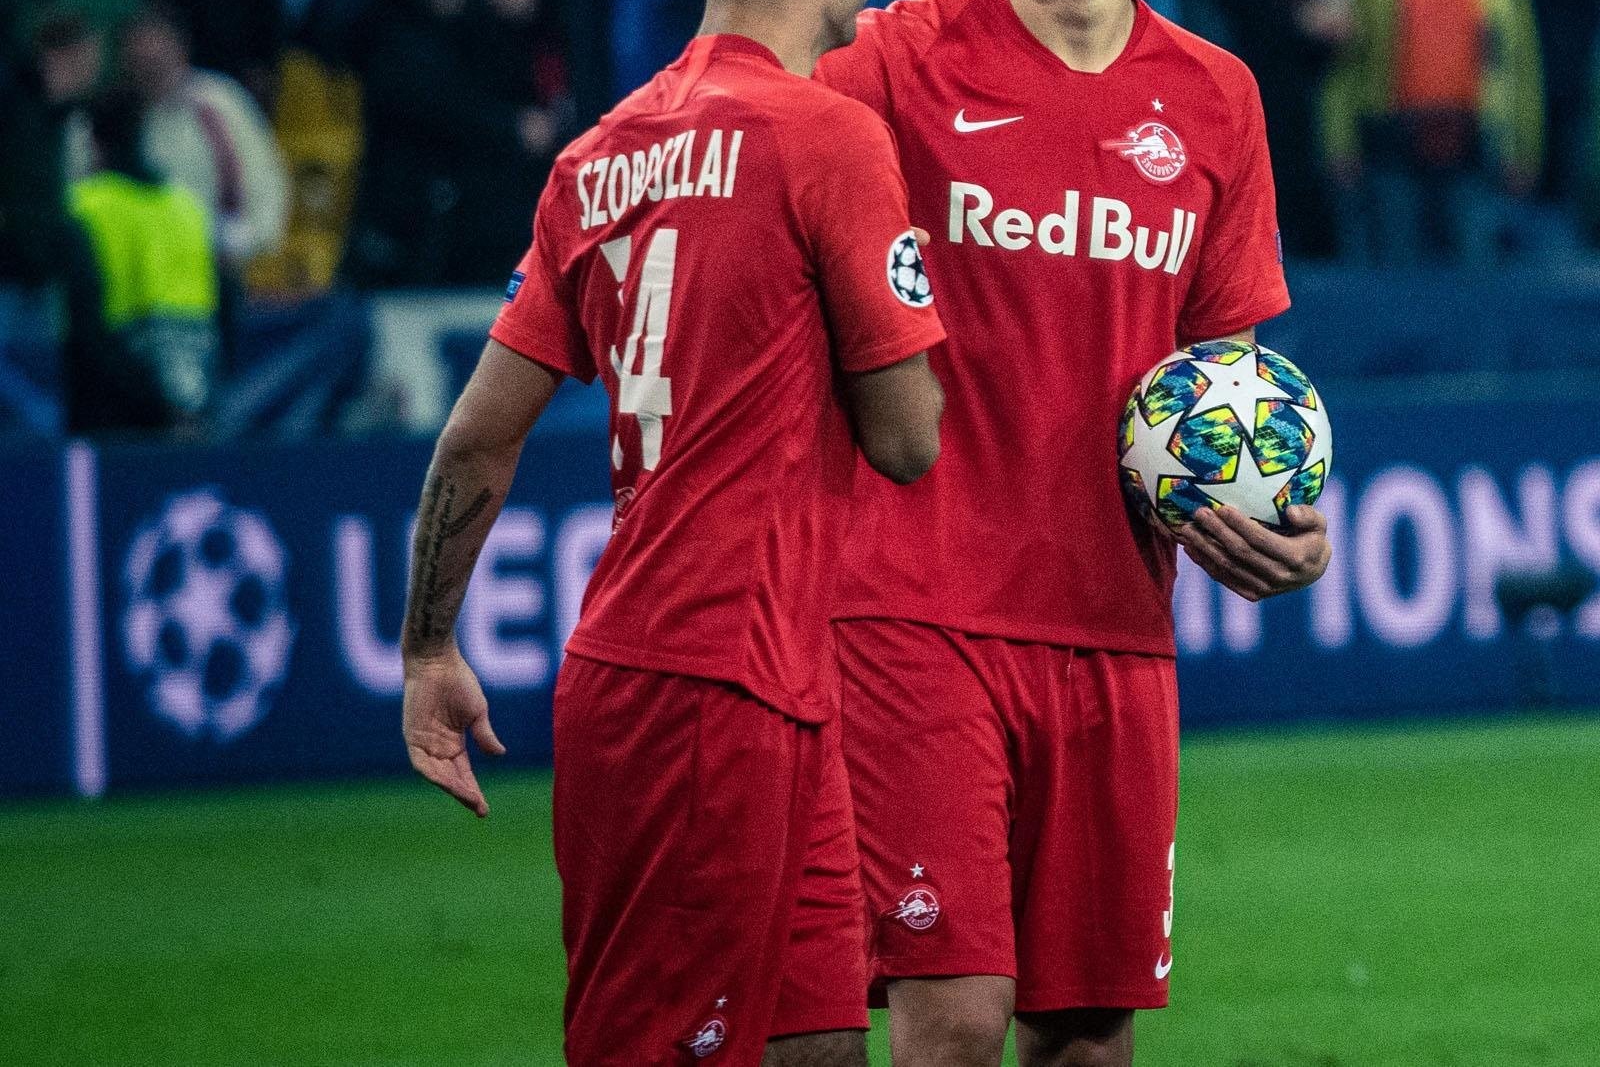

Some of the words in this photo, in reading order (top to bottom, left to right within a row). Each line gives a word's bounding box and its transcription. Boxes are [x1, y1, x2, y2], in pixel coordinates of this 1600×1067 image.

[1153, 126, 1165, 137] FC
[949, 181, 1079, 257] Red
[1089, 196, 1196, 275] Bull
[599, 228, 678, 471] 4
